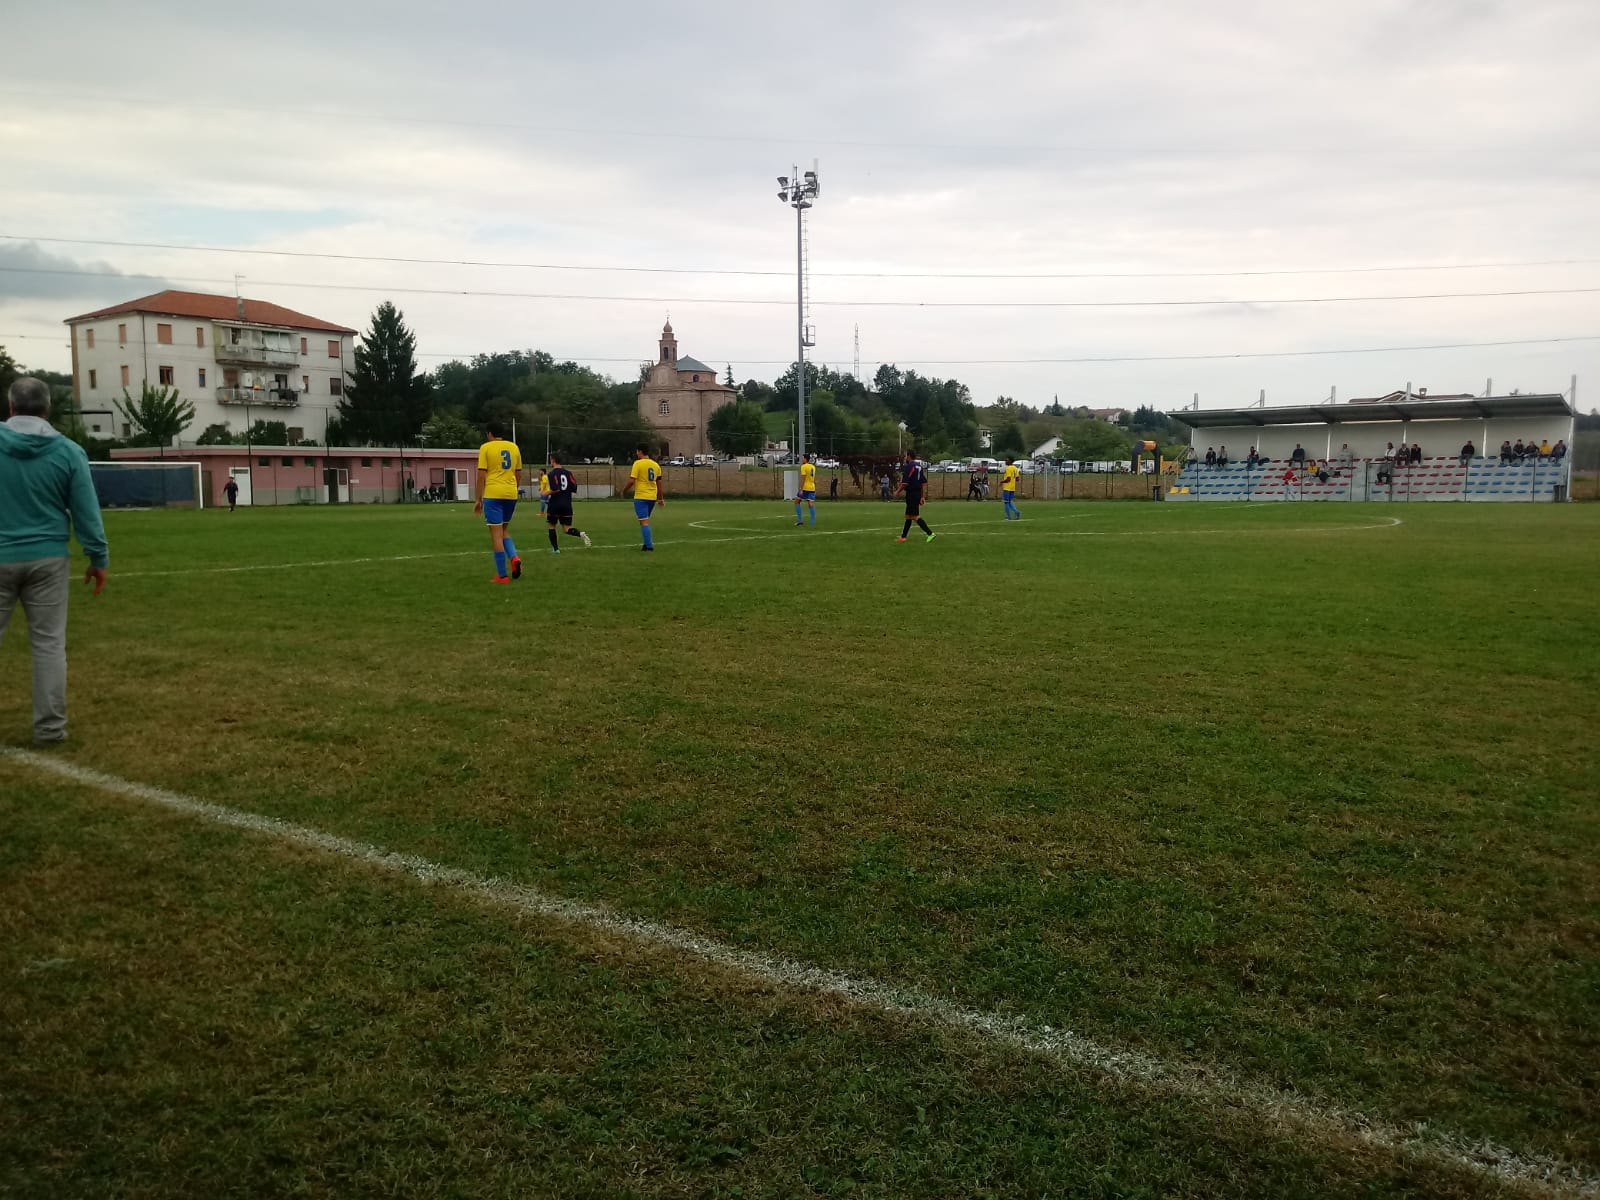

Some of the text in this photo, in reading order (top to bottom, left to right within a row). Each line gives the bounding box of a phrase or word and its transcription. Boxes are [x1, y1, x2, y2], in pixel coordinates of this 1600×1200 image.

[501, 450, 512, 469] 3
[648, 468, 654, 482] 6
[915, 465, 922, 480] 7
[560, 474, 568, 491] 9
